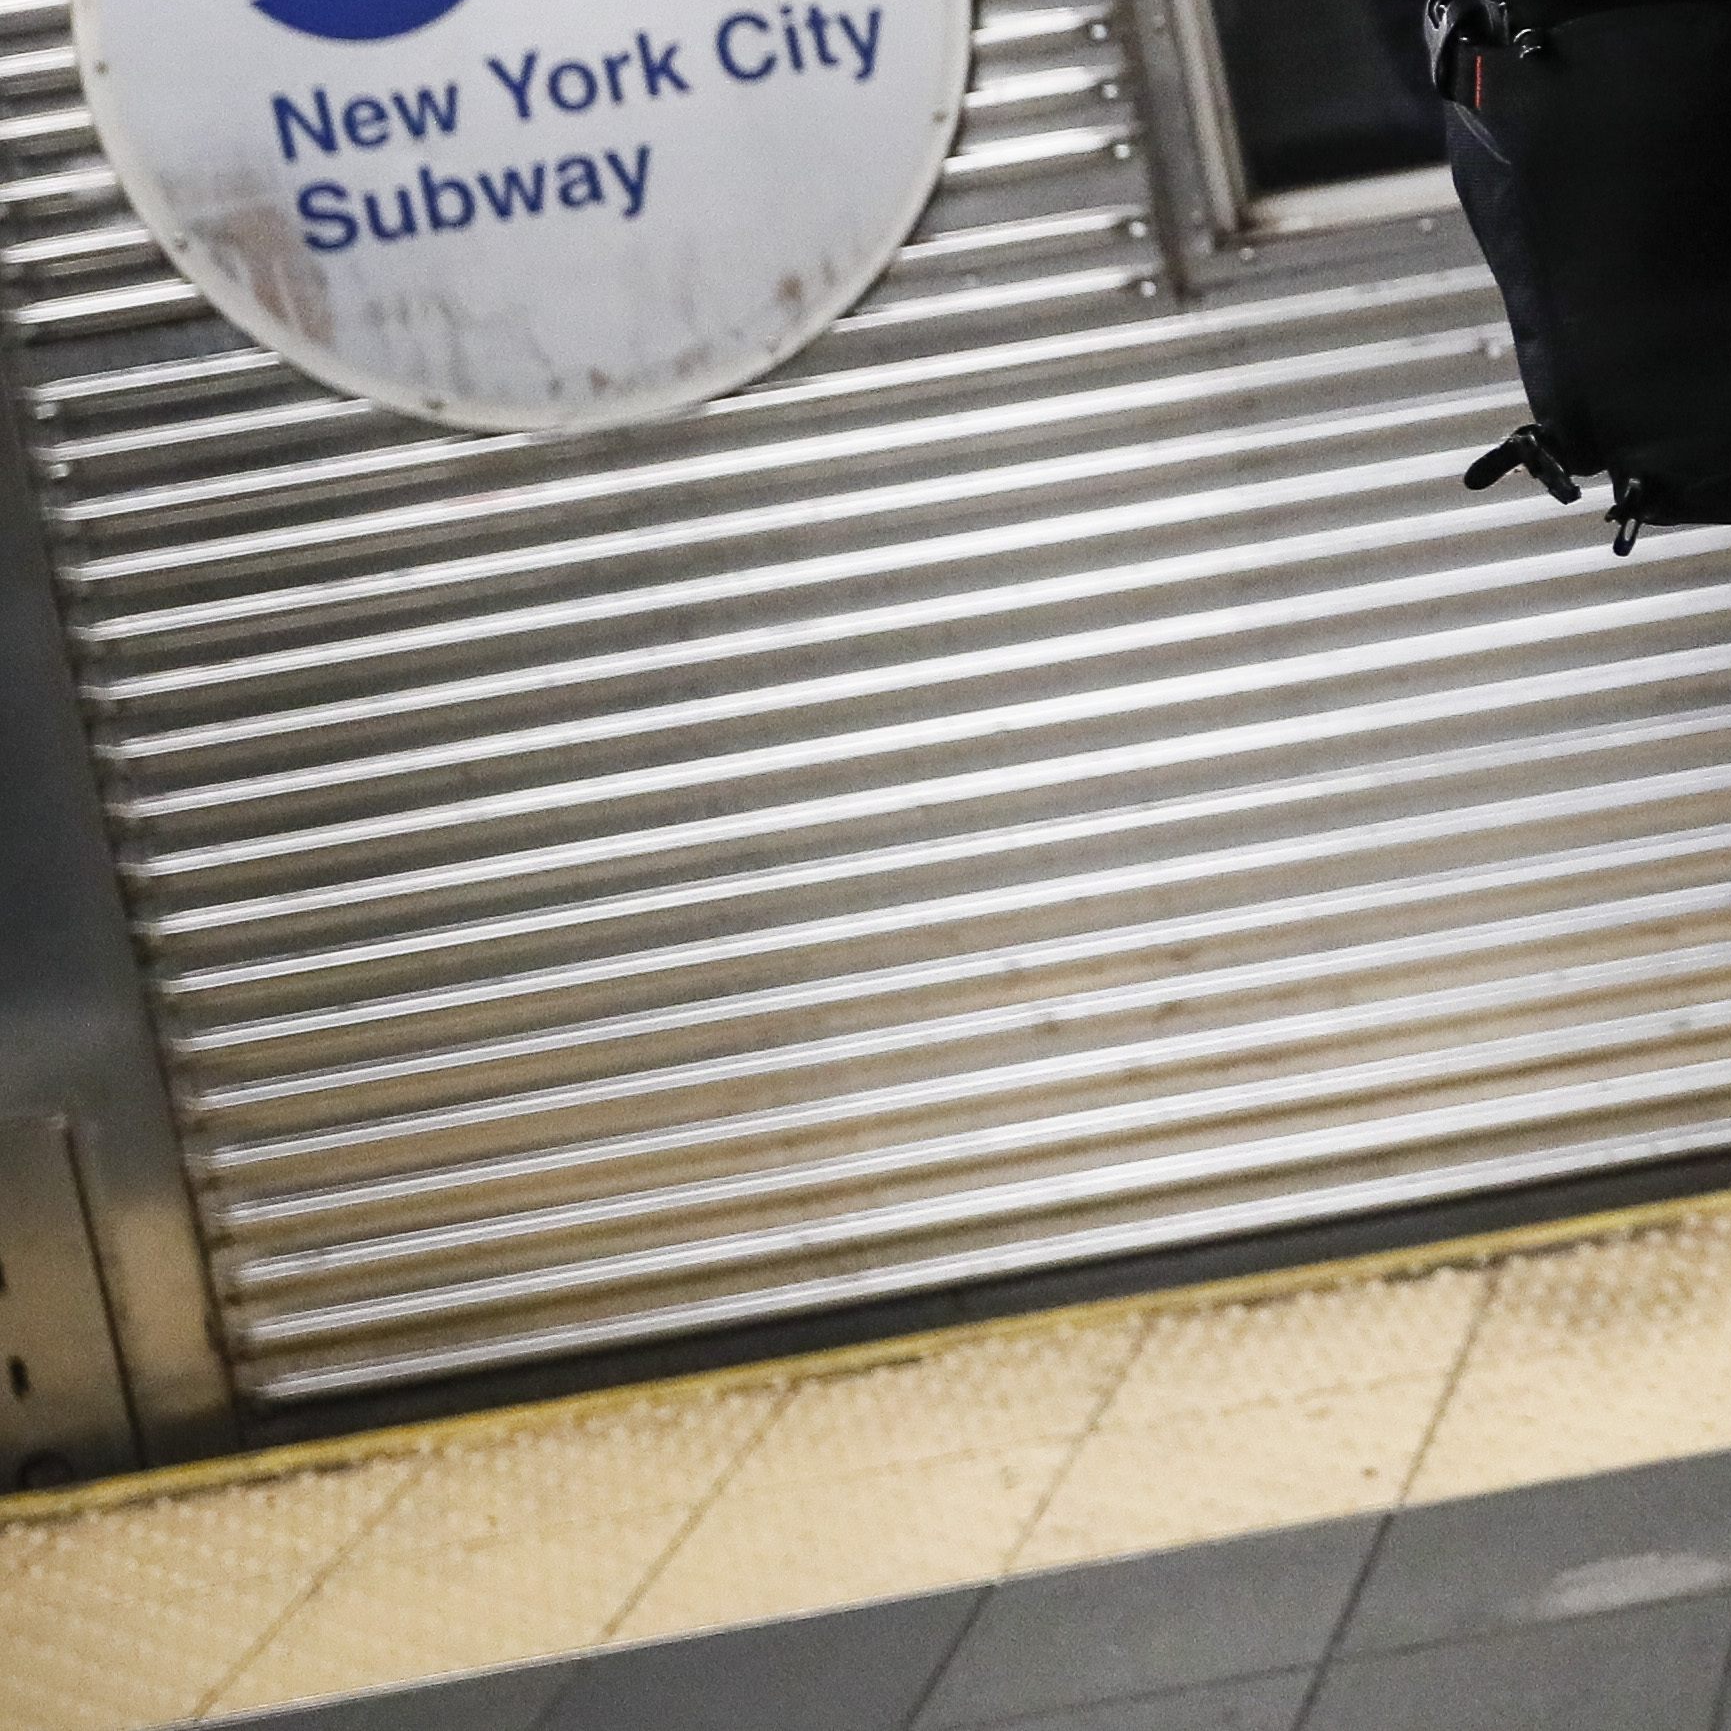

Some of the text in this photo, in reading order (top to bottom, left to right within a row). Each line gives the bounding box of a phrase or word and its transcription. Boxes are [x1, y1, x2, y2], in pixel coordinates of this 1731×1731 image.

[271, 0, 885, 164] New York City
[295, 140, 654, 255] Subway
